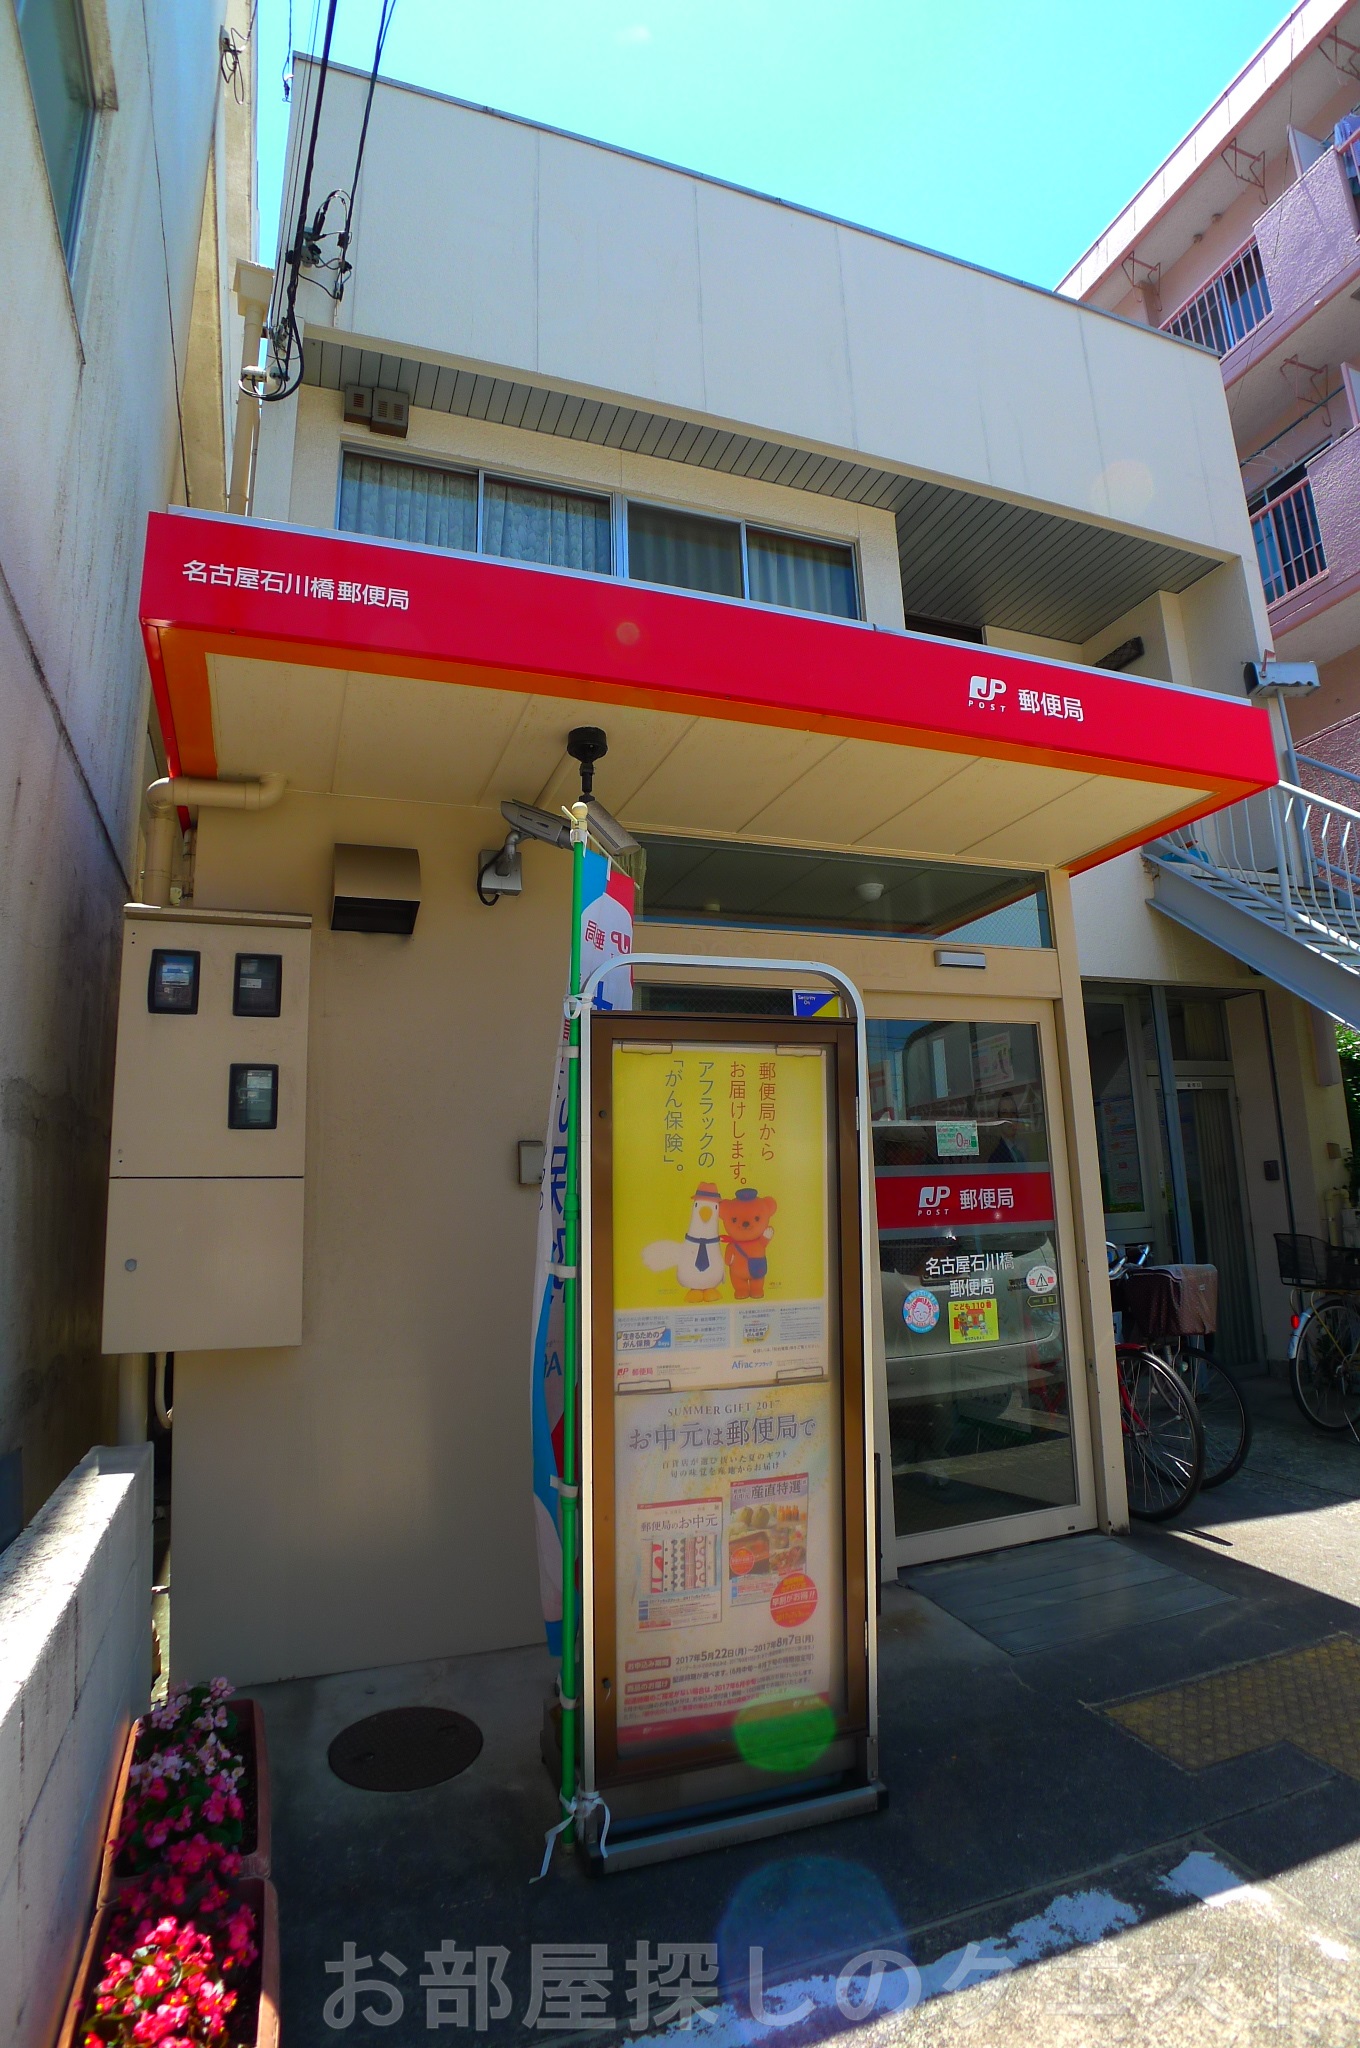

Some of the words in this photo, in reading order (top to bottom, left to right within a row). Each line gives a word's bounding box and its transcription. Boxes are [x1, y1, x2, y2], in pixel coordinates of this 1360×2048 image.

[182, 559, 410, 610] 名古屋石川橋郵便局
[968, 700, 1006, 712] POST
[1018, 688, 1084, 722] 郵便局
[663, 1059, 684, 1172] 「がん保険」。
[698, 1061, 715, 1169] アフラックの
[728, 1061, 747, 1185] お届けします。
[758, 1061, 776, 1161] 郵便局から
[959, 1187, 1015, 1210] 郵便局
[917, 1208, 949, 1216] POST
[925, 1251, 1015, 1276] 名古屋石川橋
[949, 1278, 995, 1298] 郵便局
[667, 1405, 721, 1417] SUMMER
[724, 1402, 752, 1414] GIFT
[629, 1414, 817, 1451] お中元は郵便局で
[751, 1480, 801, 1499] 産直特選
[640, 1513, 719, 1532] 郵便局のお中元
